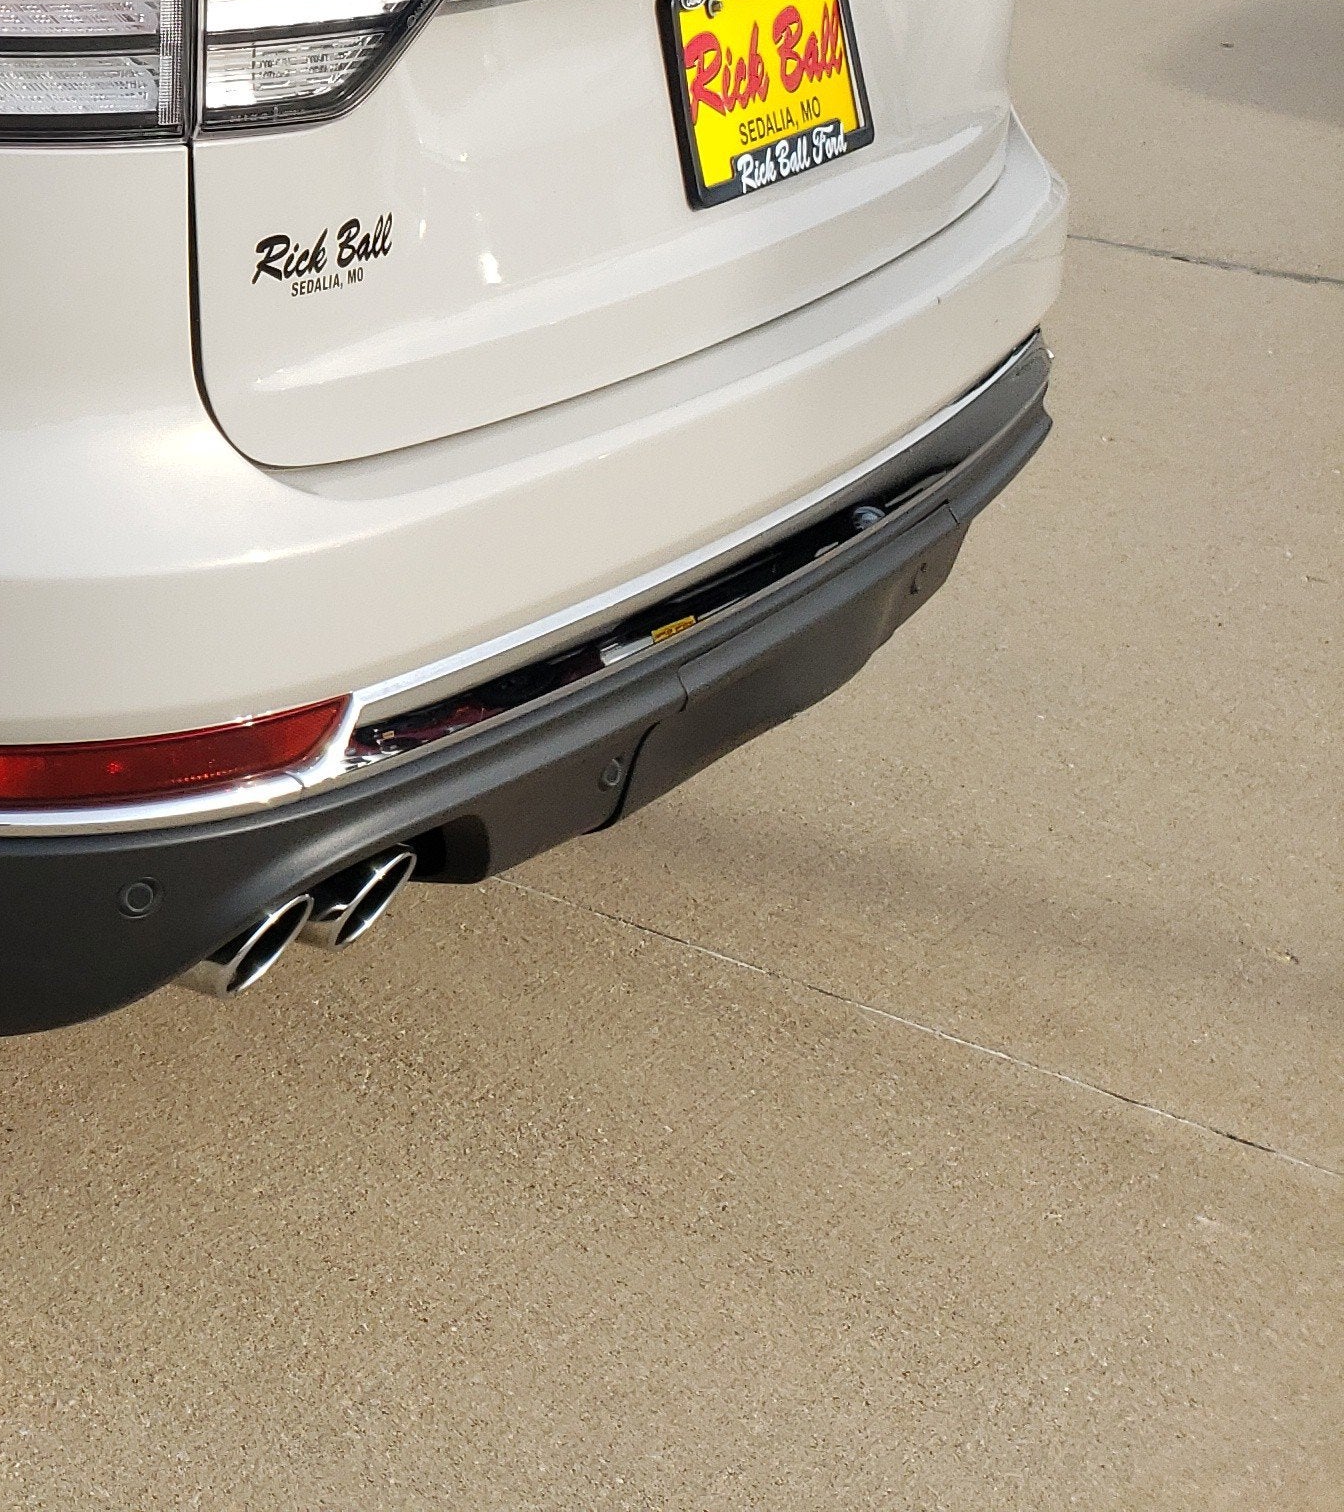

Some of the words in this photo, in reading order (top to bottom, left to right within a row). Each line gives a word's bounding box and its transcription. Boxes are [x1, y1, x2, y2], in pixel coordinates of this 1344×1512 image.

[683, 19, 770, 127] Rick
[738, 105, 800, 146] SEDALIA,
[800, 95, 821, 125] MO
[736, 153, 777, 194] Rick
[775, 134, 811, 178] Ball
[812, 122, 848, 163] Ford
[251, 227, 328, 285] Rick
[336, 211, 393, 269] Ball
[291, 273, 344, 297] SEDALIA,
[347, 266, 364, 285] MO
